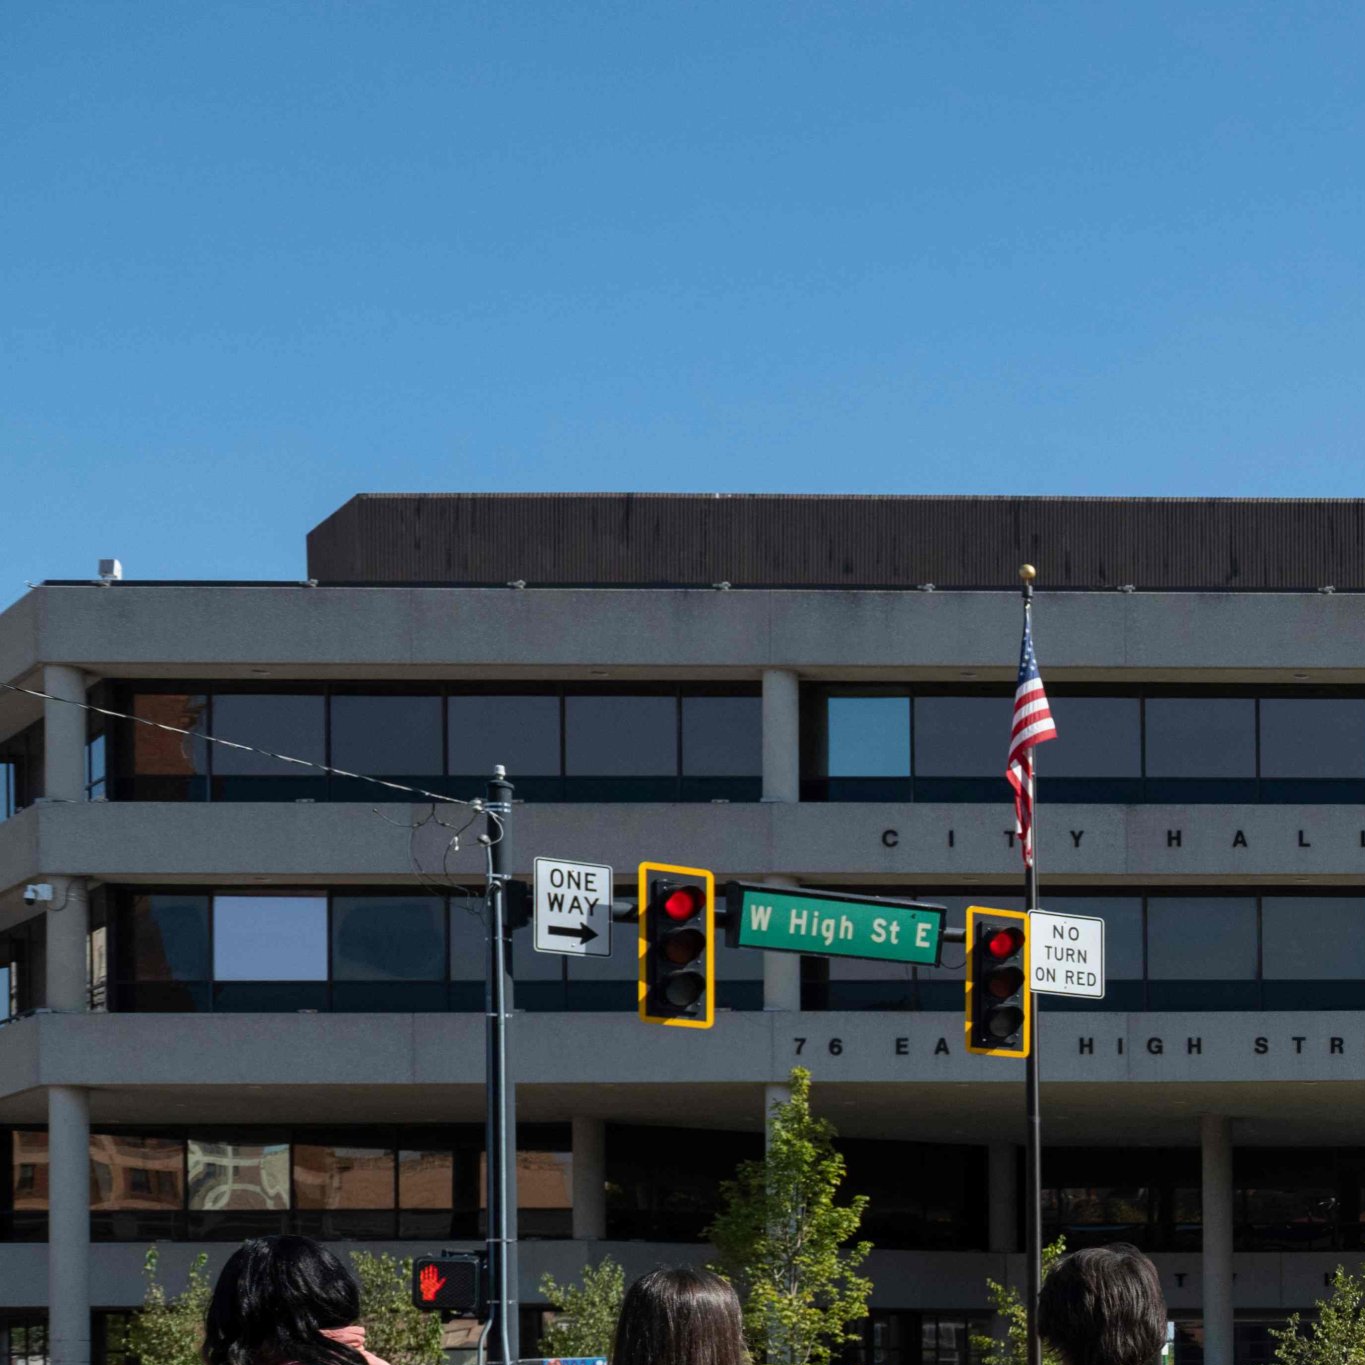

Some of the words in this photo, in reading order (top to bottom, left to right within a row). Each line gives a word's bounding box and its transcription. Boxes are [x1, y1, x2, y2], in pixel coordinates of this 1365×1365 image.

[882, 829, 1084, 848] CITY
[549, 868, 598, 893] ONE
[547, 892, 600, 917] WAY
[750, 905, 771, 932] W
[789, 909, 854, 946] High
[870, 917, 901, 945] St
[915, 923, 932, 948] E
[1052, 923, 1080, 942] NO
[1044, 945, 1088, 964] TURN
[1035, 965, 1060, 984] ON
[1065, 968, 1097, 988] RED
[793, 1036, 843, 1055] 76
[895, 1036, 951, 1055] EA
[1078, 1036, 1202, 1056] HIGH
